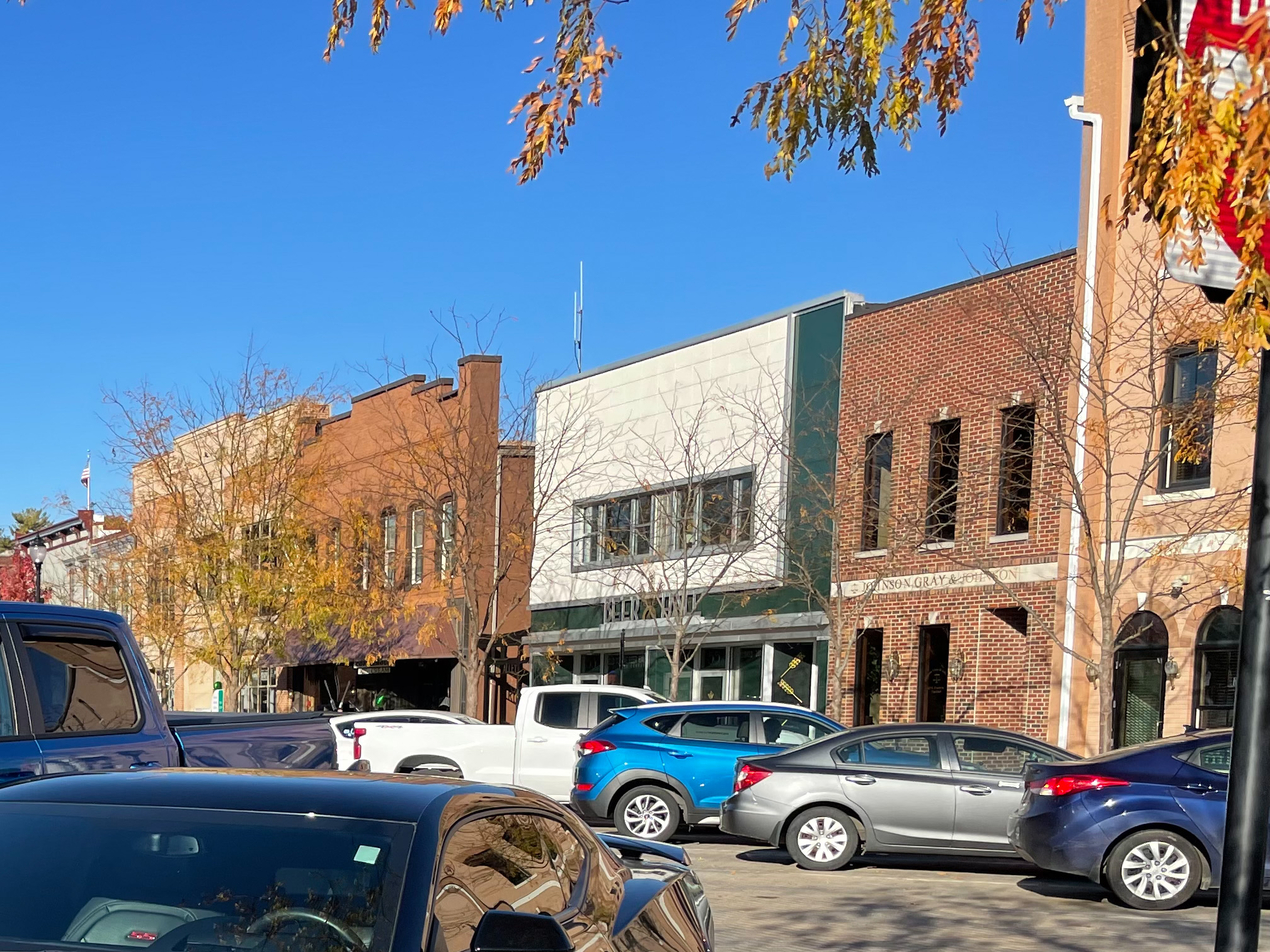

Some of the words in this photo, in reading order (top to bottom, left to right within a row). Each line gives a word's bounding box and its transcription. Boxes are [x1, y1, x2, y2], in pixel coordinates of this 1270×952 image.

[914, 575, 946, 588] GRAY
[948, 574, 957, 585] &
[603, 596, 640, 624] BEER
